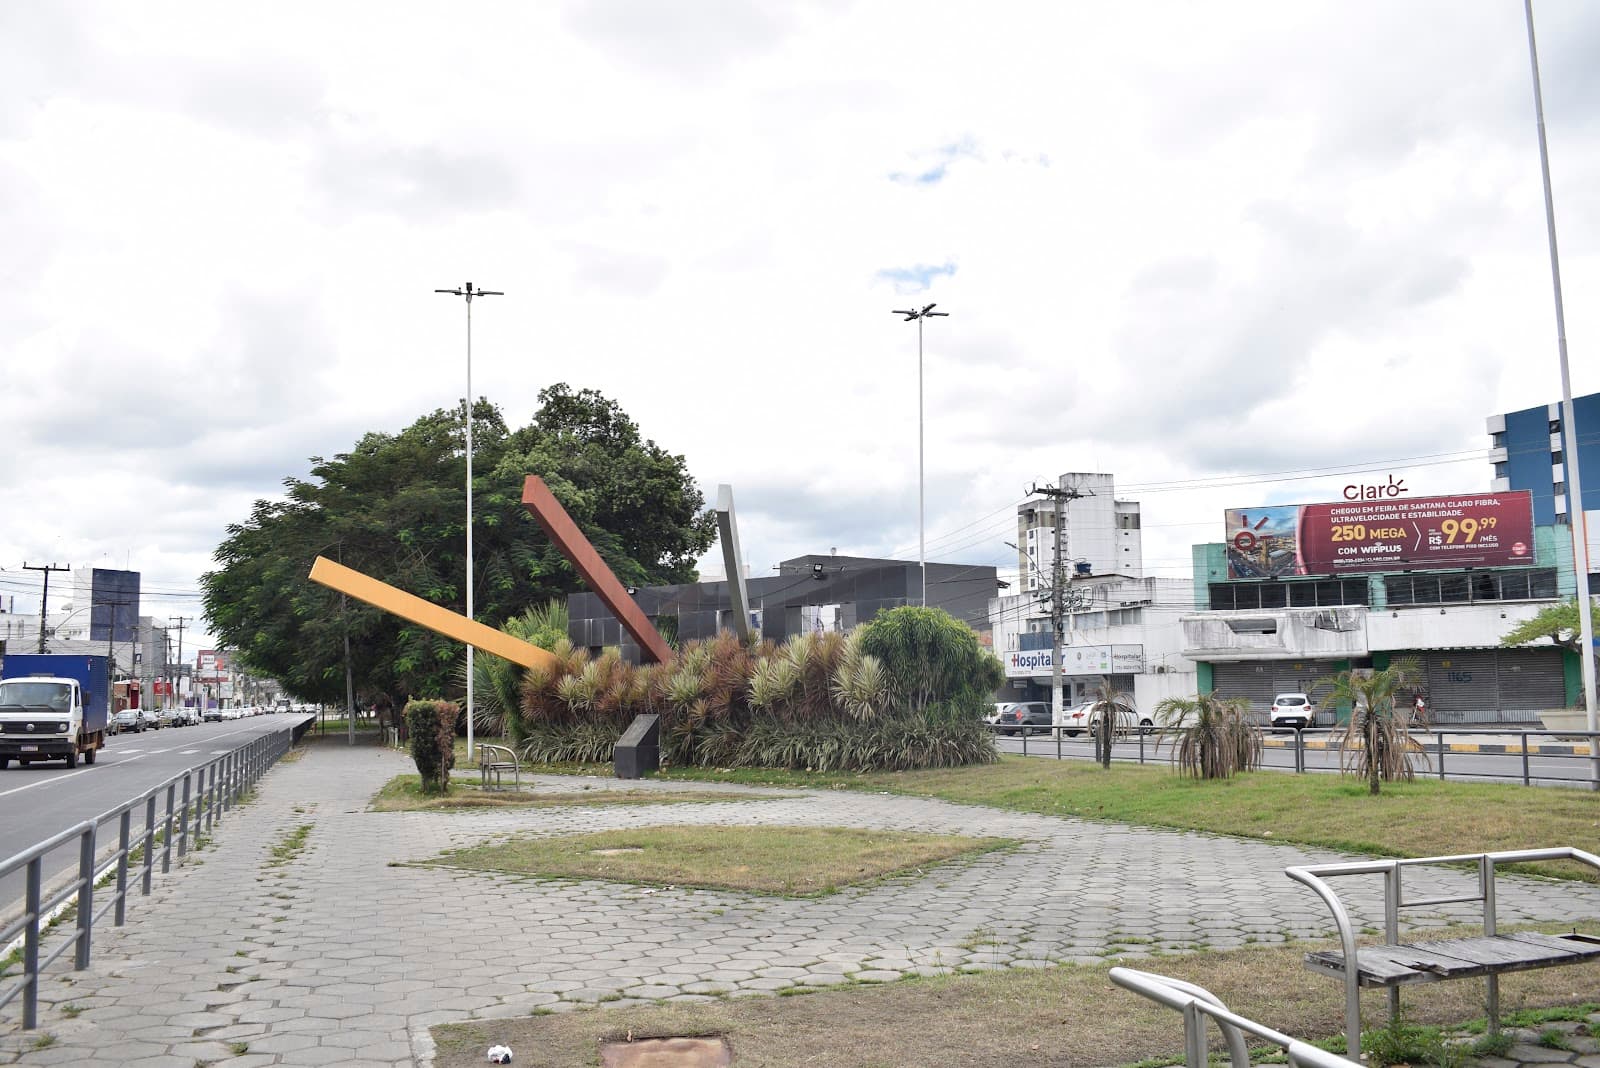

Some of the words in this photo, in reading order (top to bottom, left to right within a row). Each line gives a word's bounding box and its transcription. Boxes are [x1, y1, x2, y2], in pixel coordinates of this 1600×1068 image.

[1343, 479, 1404, 500] Claro
[1331, 507, 1361, 515] CHEGOU
[1410, 502, 1446, 510] SANTANA
[1447, 500, 1473, 508] CLARO
[1331, 513, 1400, 523] ULTRAVELOCIDADE
[1408, 510, 1464, 518] ESTABILIDADE.
[1331, 524, 1366, 542] 250
[1370, 528, 1407, 540] MEGA
[1428, 536, 1442, 545] R$
[1338, 547, 1358, 555] COM
[1012, 652, 1066, 670] Hospitalr
